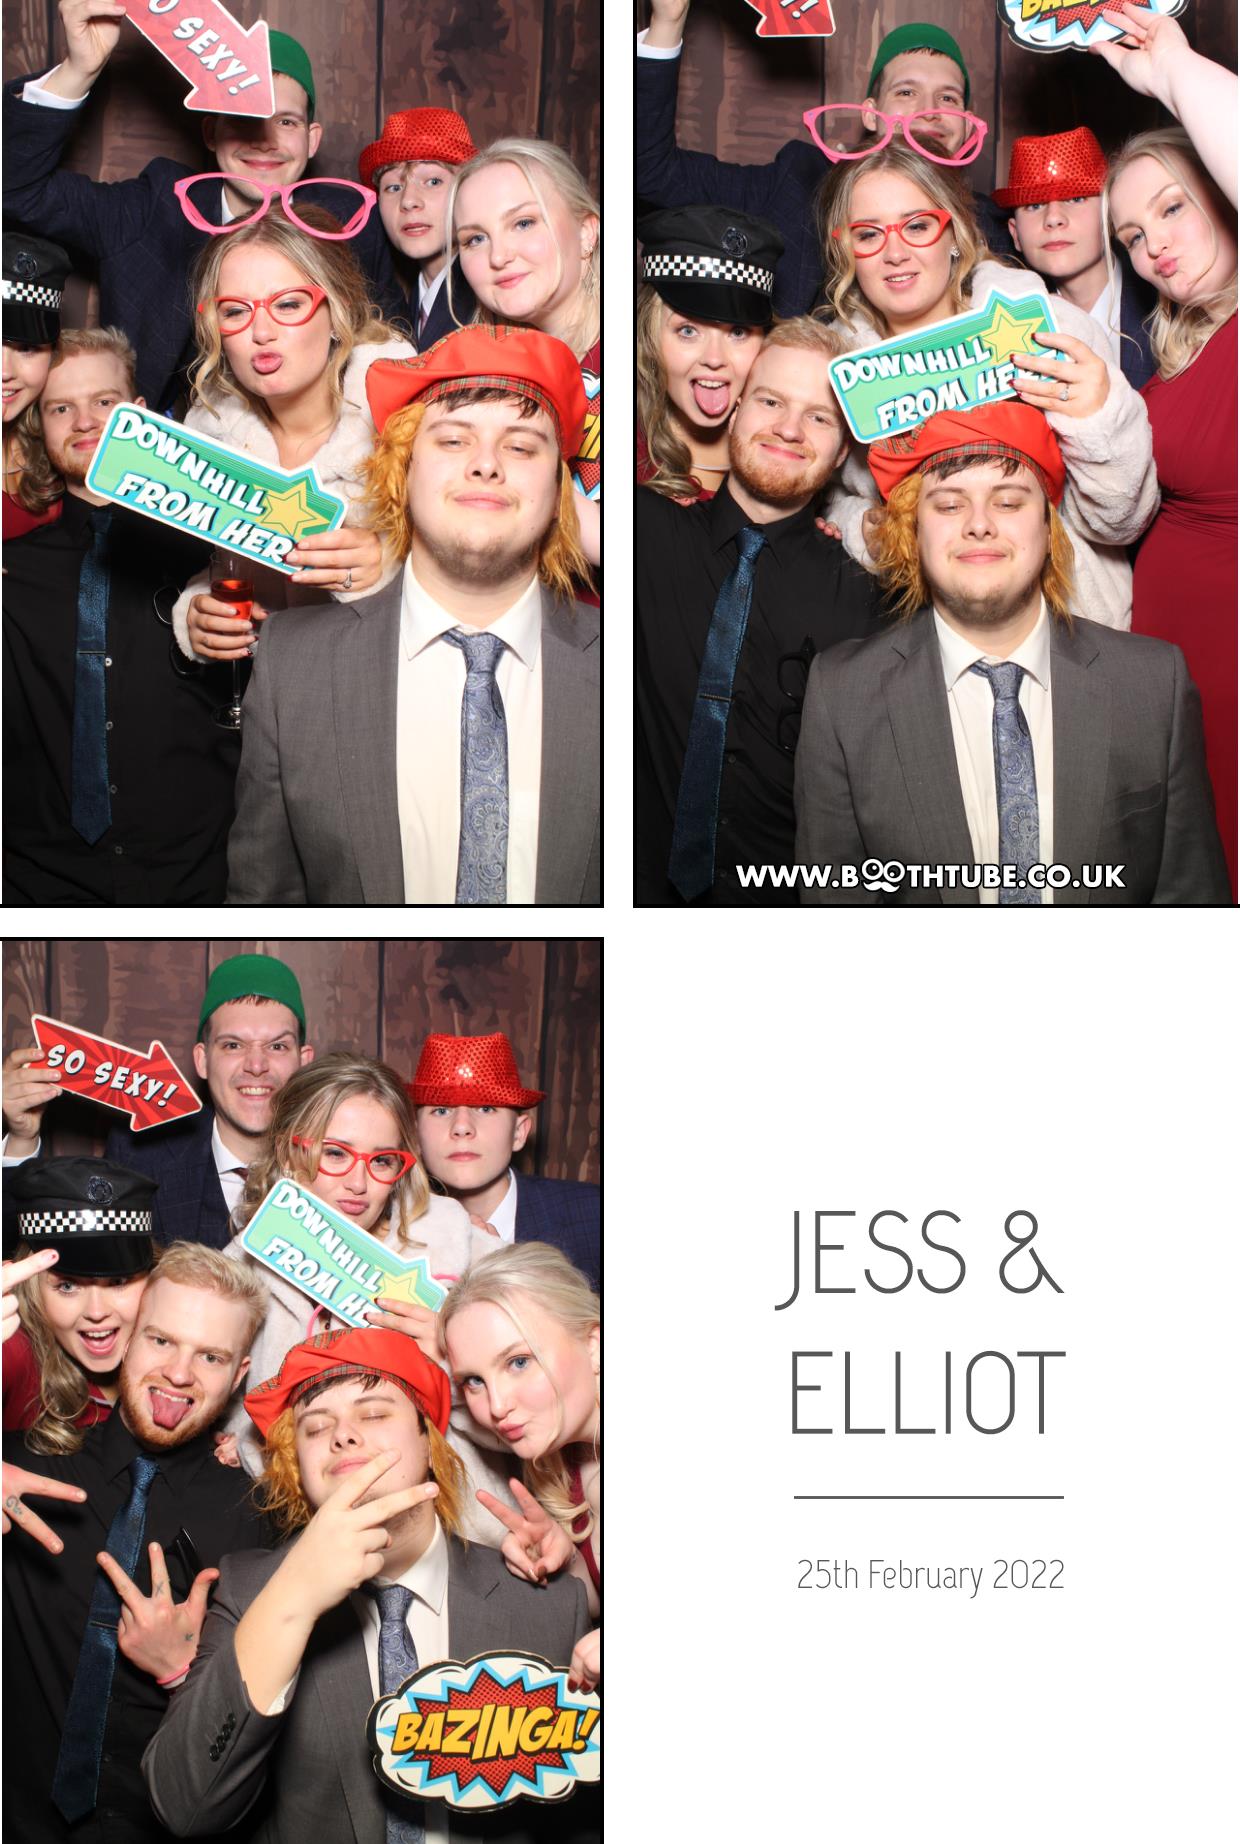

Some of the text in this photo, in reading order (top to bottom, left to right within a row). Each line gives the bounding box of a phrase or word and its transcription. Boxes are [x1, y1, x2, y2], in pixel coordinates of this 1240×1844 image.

[148, 0, 261, 96] O SEXY!
[834, 335, 992, 392] DOWNHILL
[877, 350, 1058, 432] FROM HE
[112, 411, 268, 516] DOWNHILL
[115, 472, 300, 566] FROM HER
[47, 1044, 178, 1107] SO SEXY!
[262, 1236, 384, 1328] FROM HE
[271, 1184, 384, 1293] DOWNHILL
[391, 1703, 600, 1763] BAZINGA!
